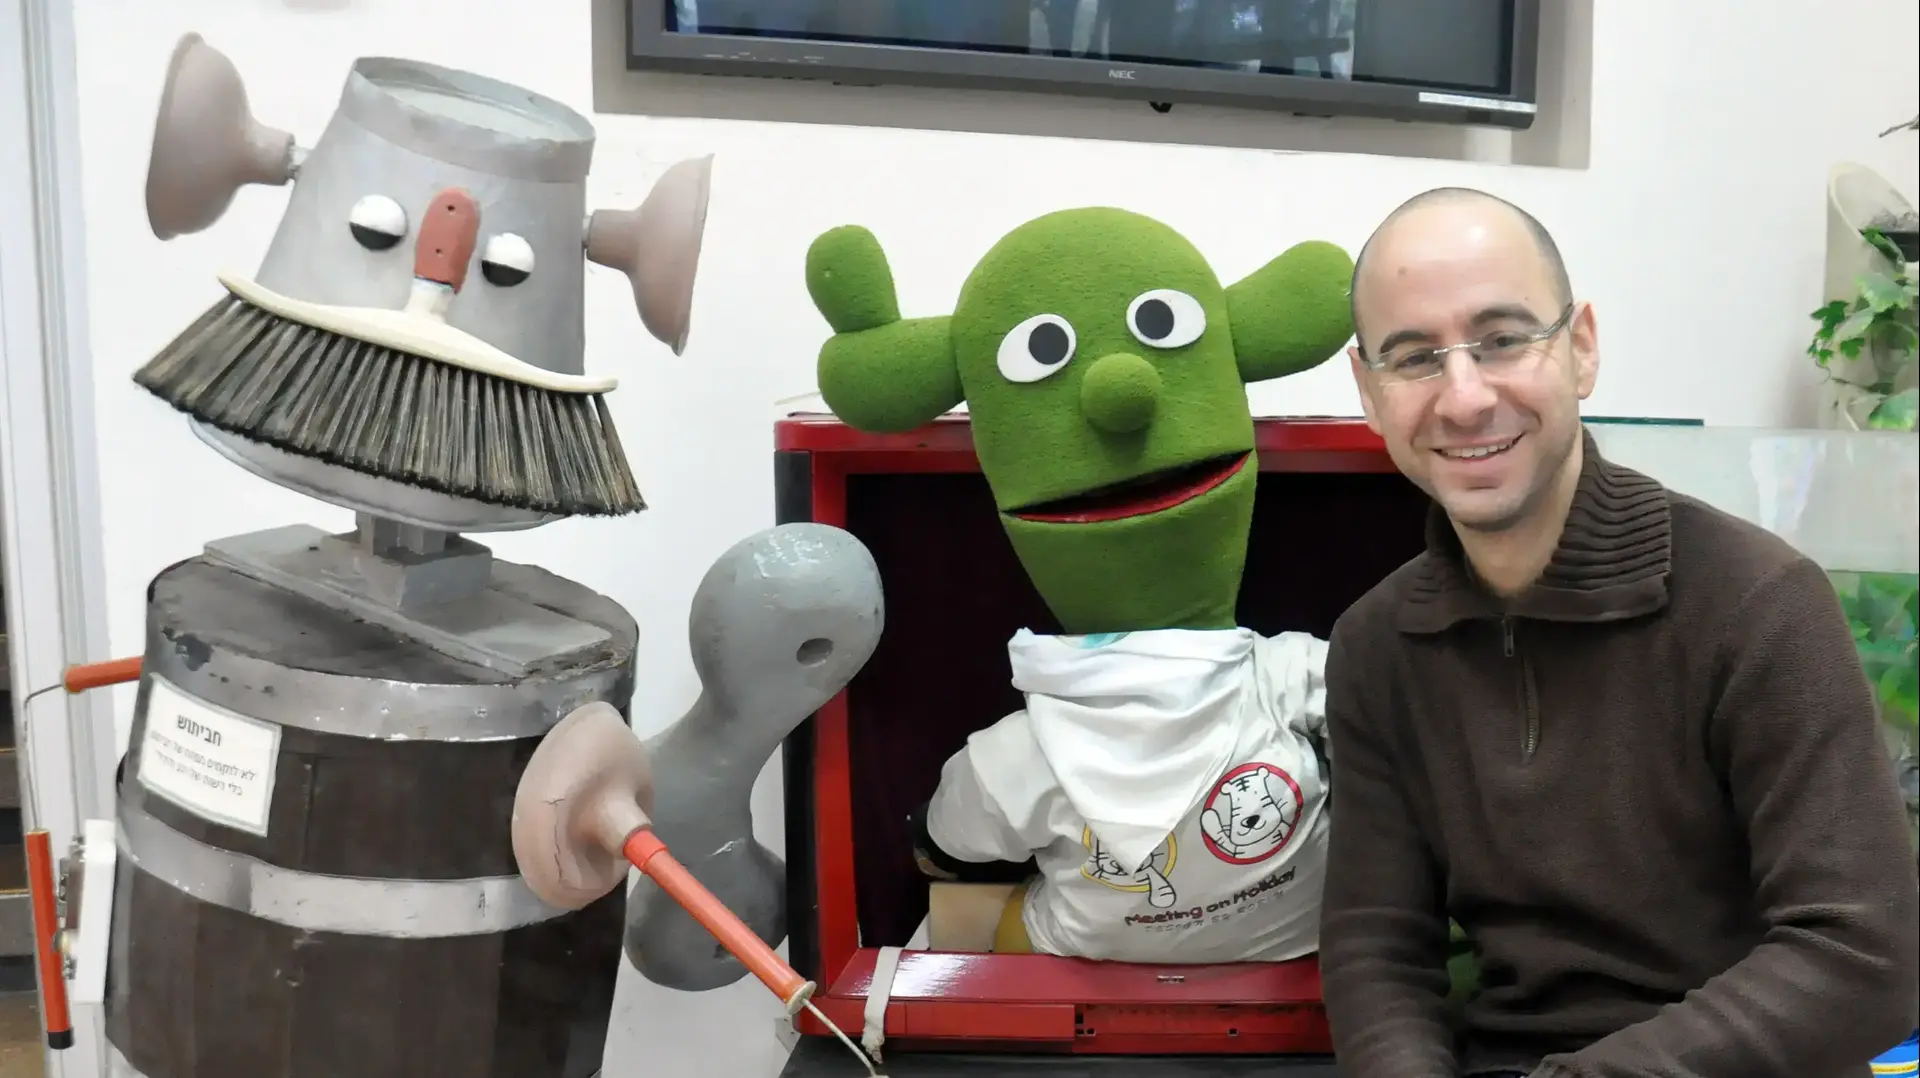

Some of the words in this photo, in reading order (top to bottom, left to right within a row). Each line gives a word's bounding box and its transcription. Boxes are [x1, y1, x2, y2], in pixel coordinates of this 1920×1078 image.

[1109, 69, 1136, 80] NEC
[177, 715, 222, 747] חביתוש
[1124, 906, 1204, 926] Meeting
[1206, 899, 1231, 913] on
[1233, 865, 1296, 904] Holiday
